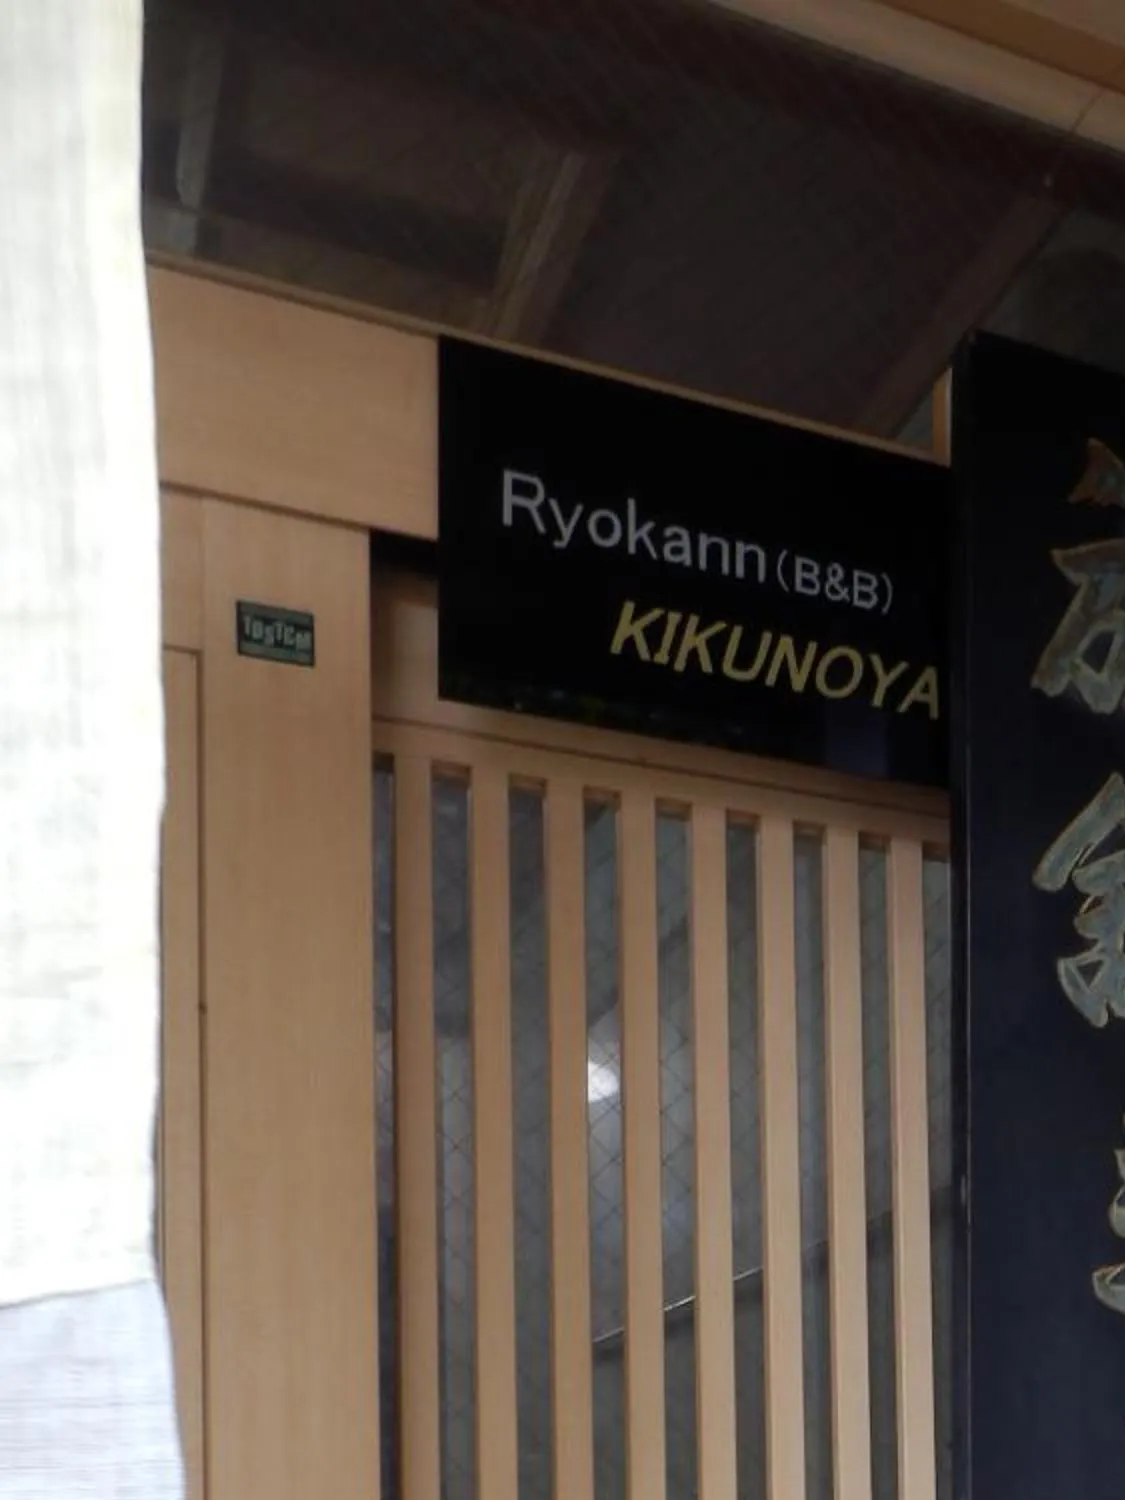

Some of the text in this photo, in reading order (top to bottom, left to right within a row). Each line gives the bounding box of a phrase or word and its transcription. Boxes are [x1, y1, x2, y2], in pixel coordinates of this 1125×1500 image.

[502, 469, 894, 614] Ryokann (B&B)
[610, 601, 940, 720] KIKUNOYA
